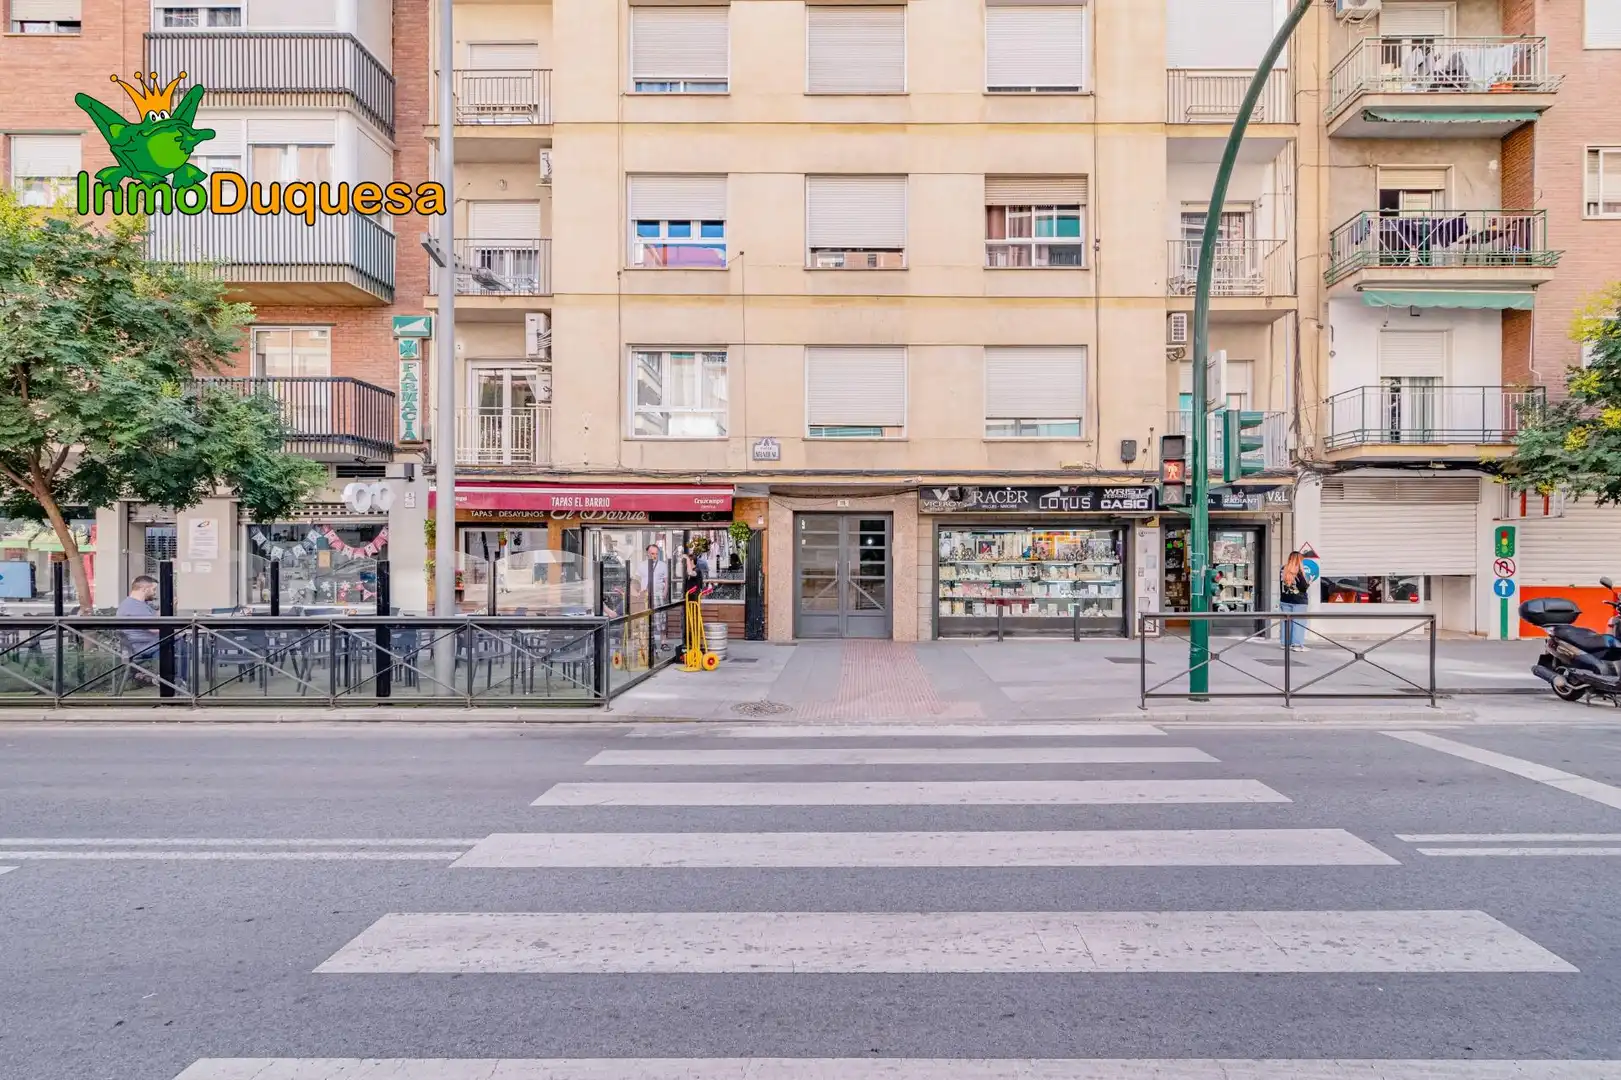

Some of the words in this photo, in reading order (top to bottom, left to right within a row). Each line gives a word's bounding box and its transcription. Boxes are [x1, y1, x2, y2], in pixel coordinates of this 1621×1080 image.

[401, 363, 418, 440] FARMACIA
[551, 497, 573, 507] TAPAS
[574, 497, 583, 507] EL
[585, 497, 610, 507] BARRIO
[973, 490, 1029, 503] RACER
[1267, 491, 1289, 502] V&L
[1039, 497, 1091, 509] LOTUS
[1101, 499, 1149, 509] CASIO
